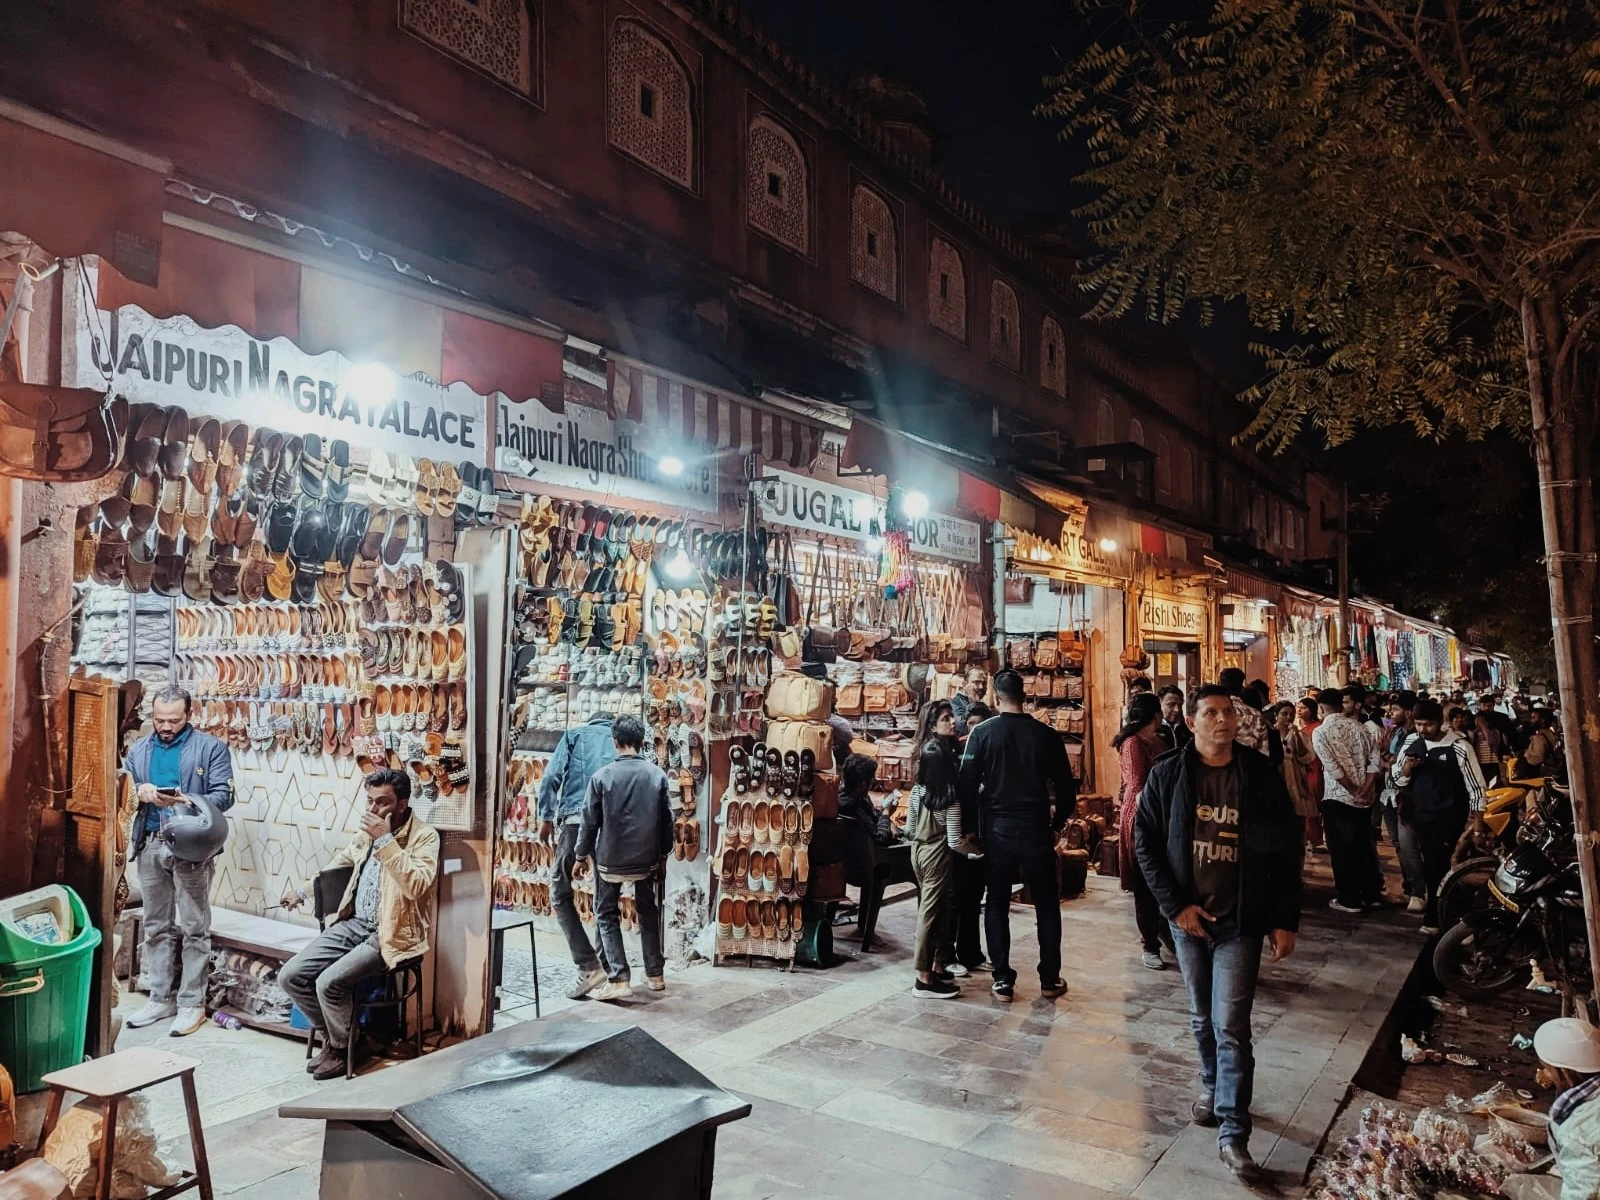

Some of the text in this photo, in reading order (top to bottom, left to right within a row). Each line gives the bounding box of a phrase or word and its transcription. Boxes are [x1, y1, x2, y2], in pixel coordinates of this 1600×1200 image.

[91, 309, 242, 399] JAIPURI
[248, 340, 361, 425] NAGRA
[498, 404, 562, 463] Jaipuri
[567, 421, 616, 485] Nagra
[774, 480, 861, 532] JUGAL
[869, 507, 940, 548] KHOR
[1061, 530, 1076, 558] RT
[1144, 601, 1169, 627] Rishi
[1172, 605, 1195, 629] Shoes
